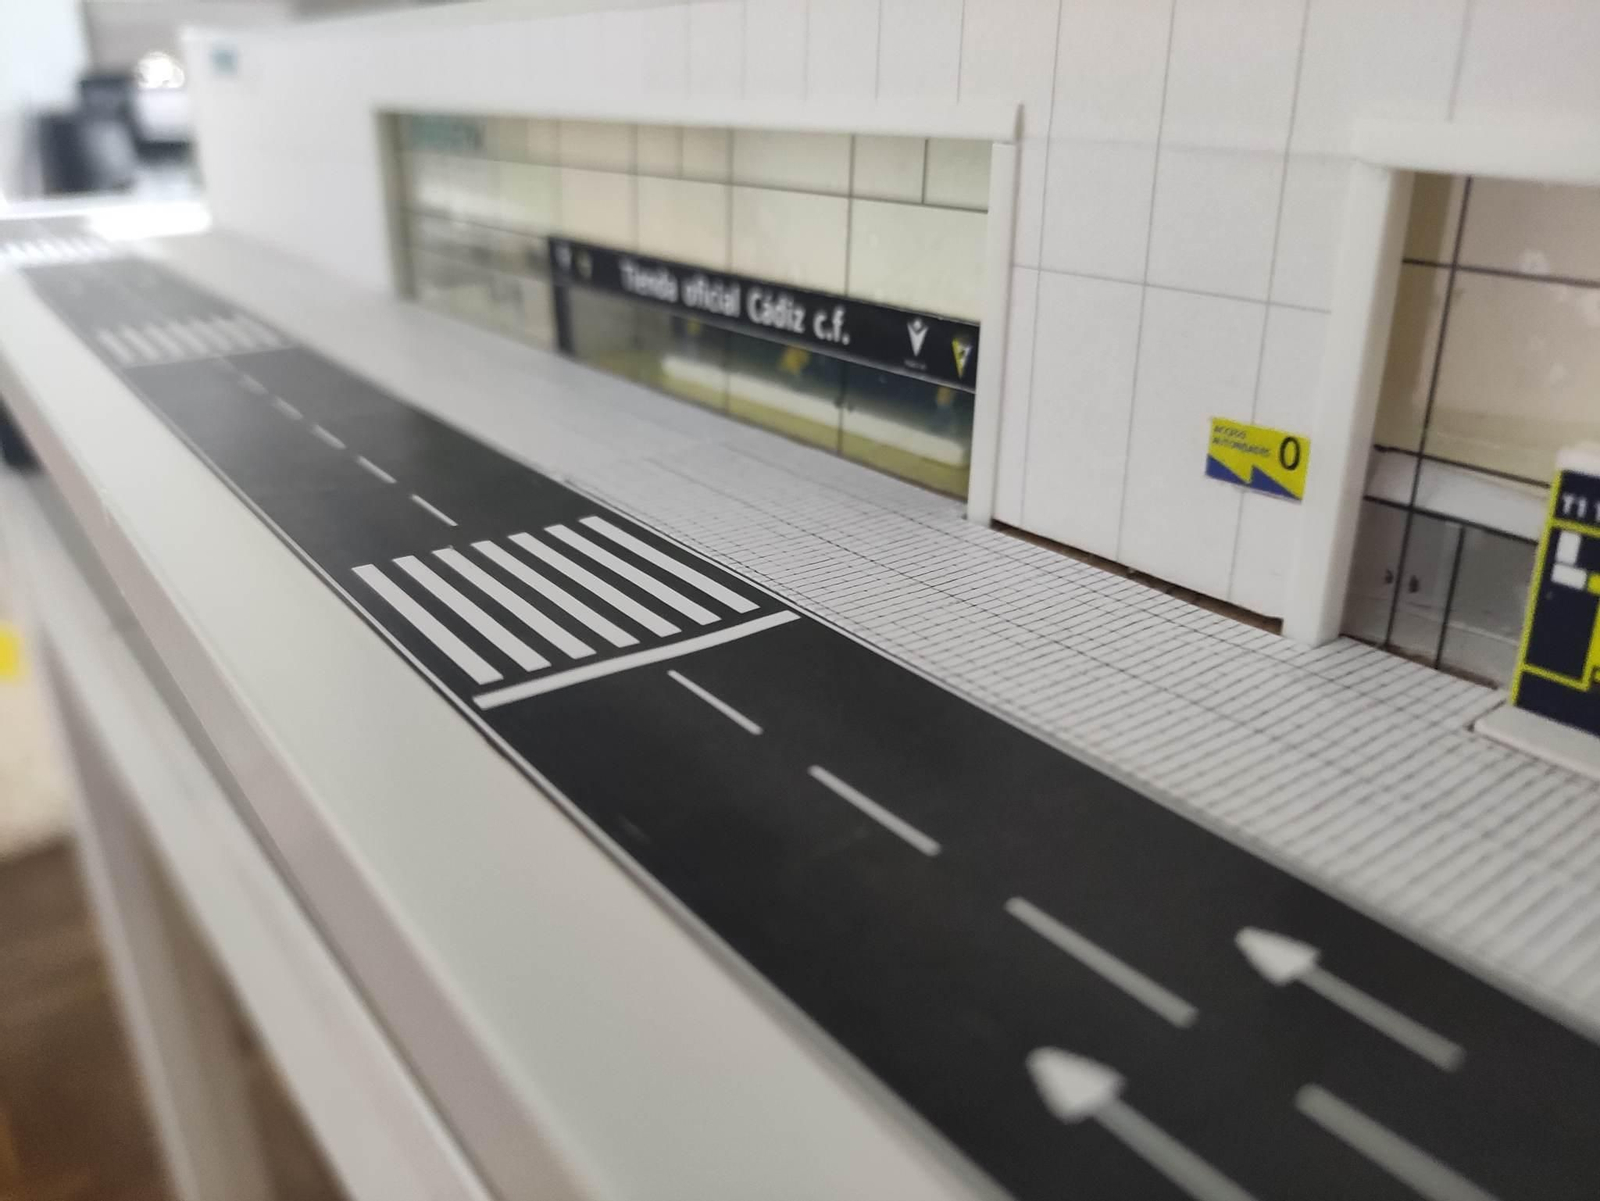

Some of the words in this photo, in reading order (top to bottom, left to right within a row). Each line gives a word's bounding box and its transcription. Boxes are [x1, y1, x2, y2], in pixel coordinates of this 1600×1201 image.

[681, 274, 740, 318] oficial
[746, 287, 805, 333] Cádiz
[813, 305, 850, 345] c.f.
